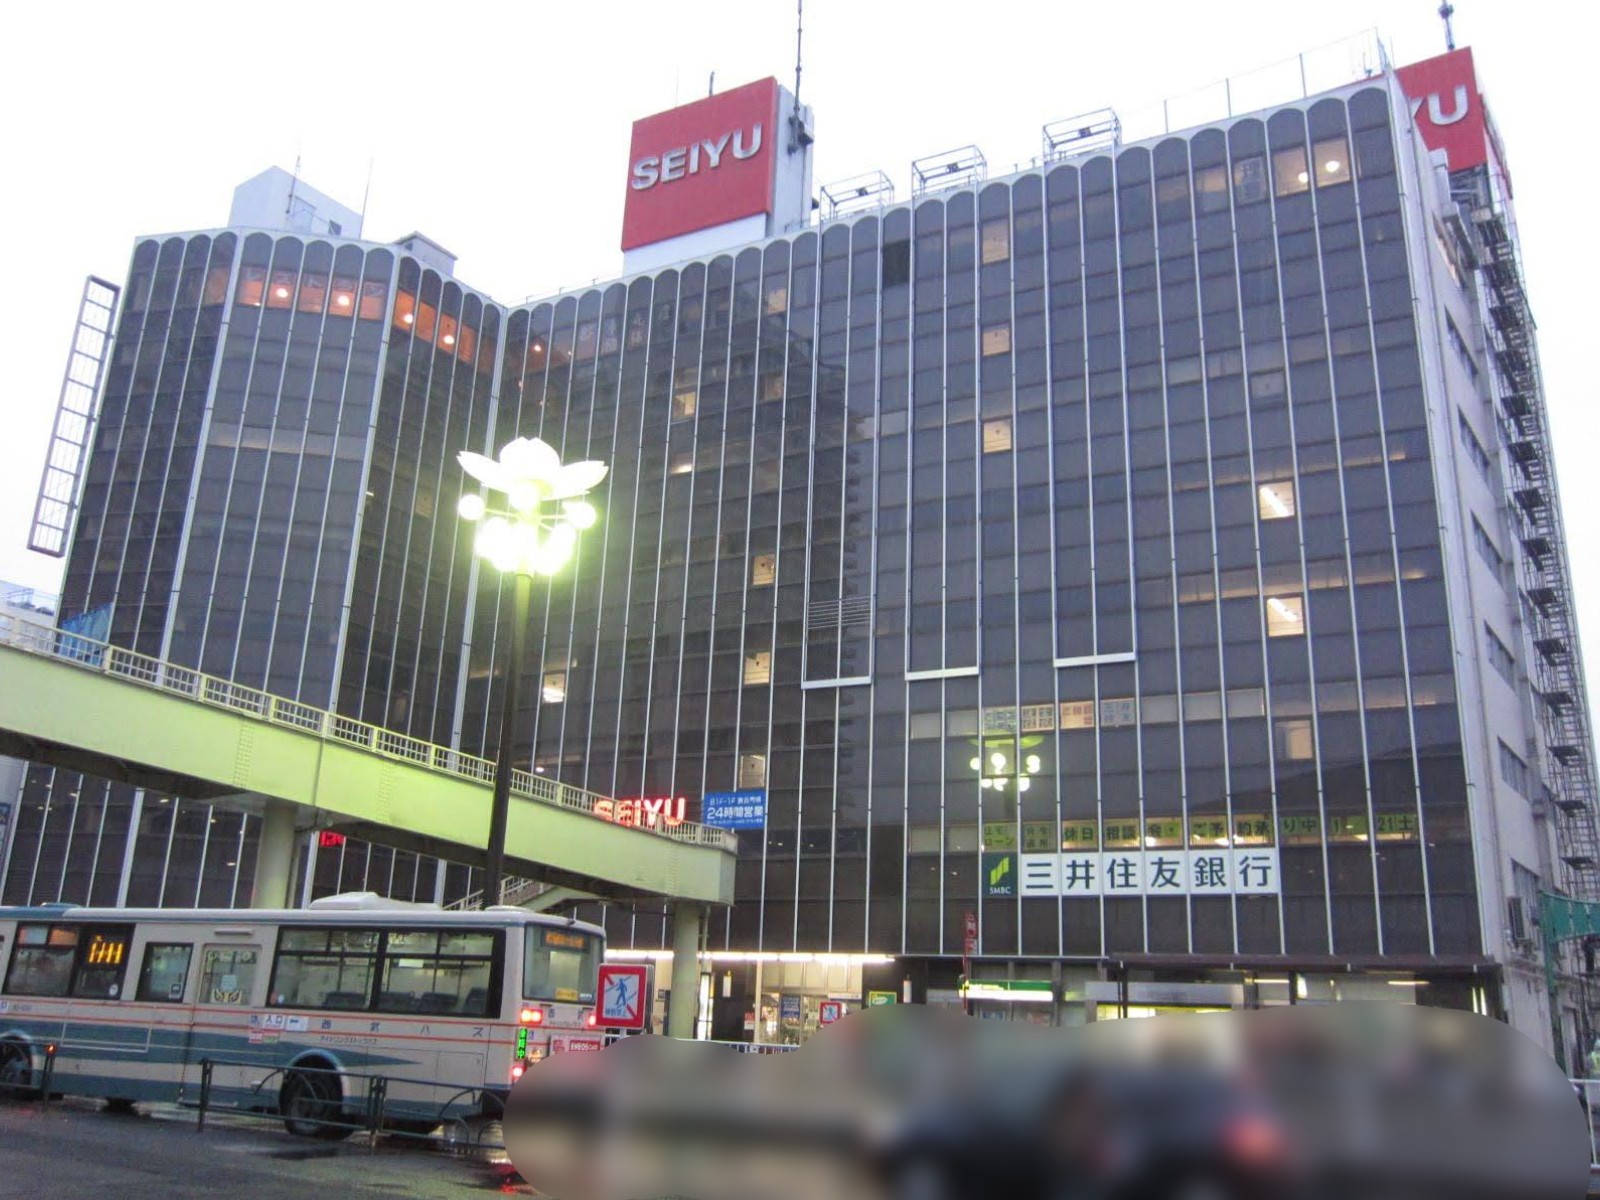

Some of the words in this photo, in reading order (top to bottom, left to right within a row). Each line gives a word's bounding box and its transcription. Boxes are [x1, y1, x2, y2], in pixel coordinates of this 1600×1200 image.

[631, 122, 763, 190] SEIYU
[706, 805, 763, 820] 24時間営業
[1026, 856, 1272, 890] 三井住友銀行
[989, 886, 1012, 895] SMBC
[265, 1014, 283, 1024] 入口
